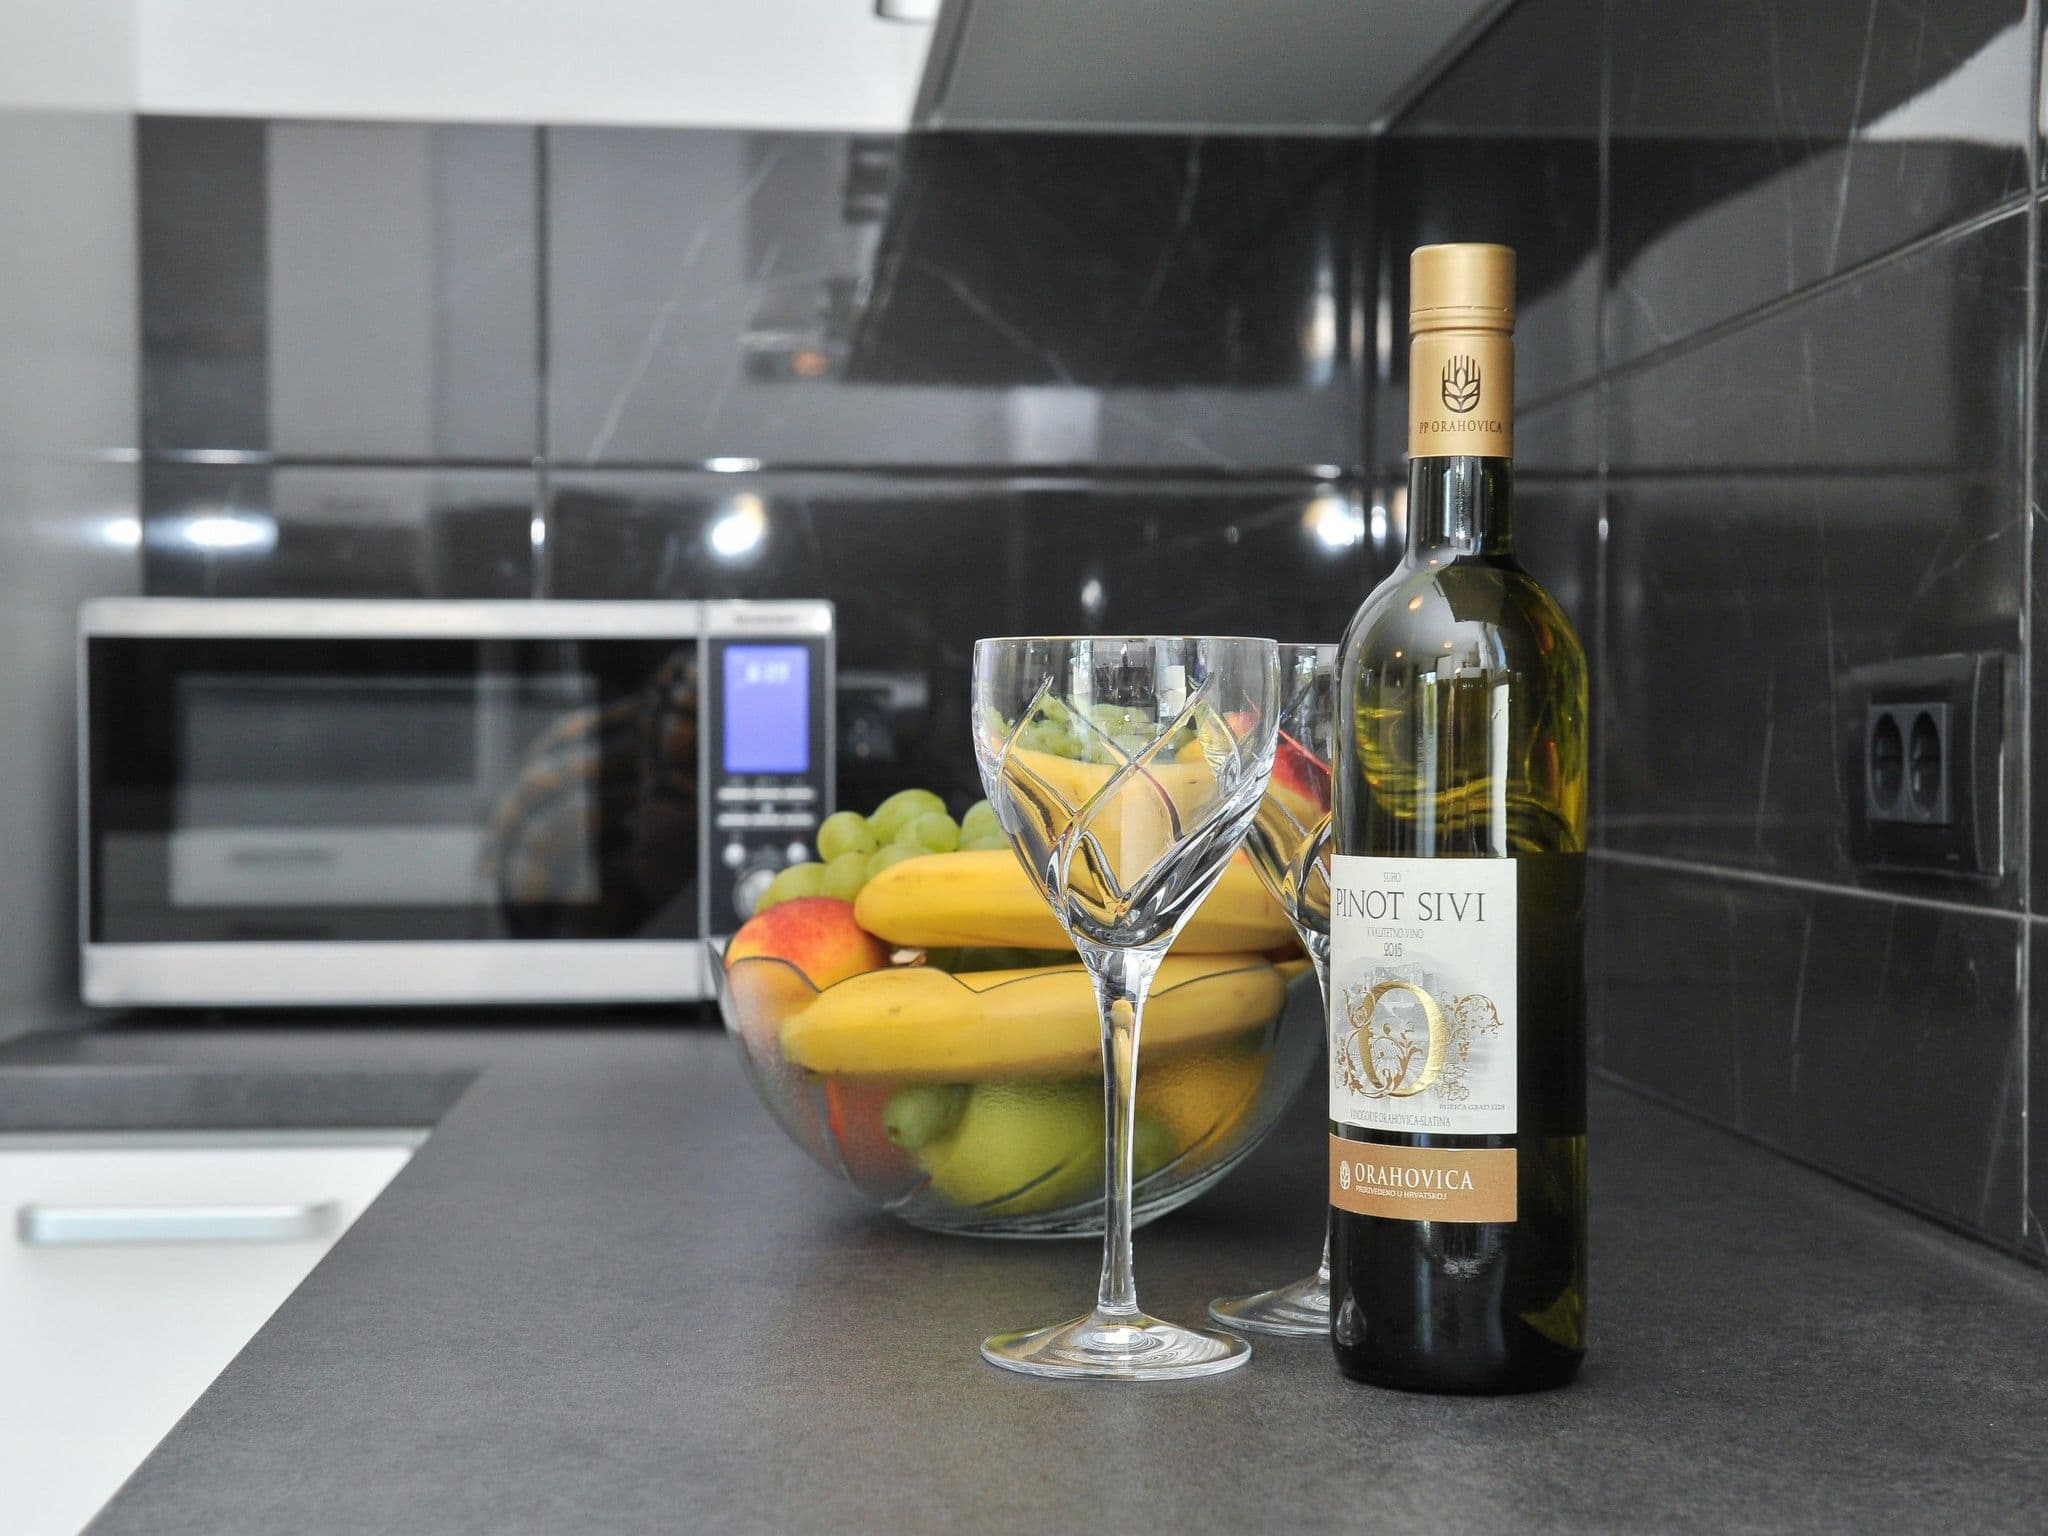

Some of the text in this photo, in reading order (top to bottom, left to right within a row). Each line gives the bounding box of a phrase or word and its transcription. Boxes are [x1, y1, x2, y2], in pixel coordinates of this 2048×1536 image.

[1419, 420, 1503, 434] PP ORAHOVICA
[1335, 887, 1487, 922] PINOT SIVI
[1383, 942, 1403, 957] 2015
[1354, 1162, 1475, 1191] ORAHOVICA
[1355, 1185, 1397, 1198] PROIZVEDENO
[1403, 1191, 1447, 1201] HRVATSKOJ
